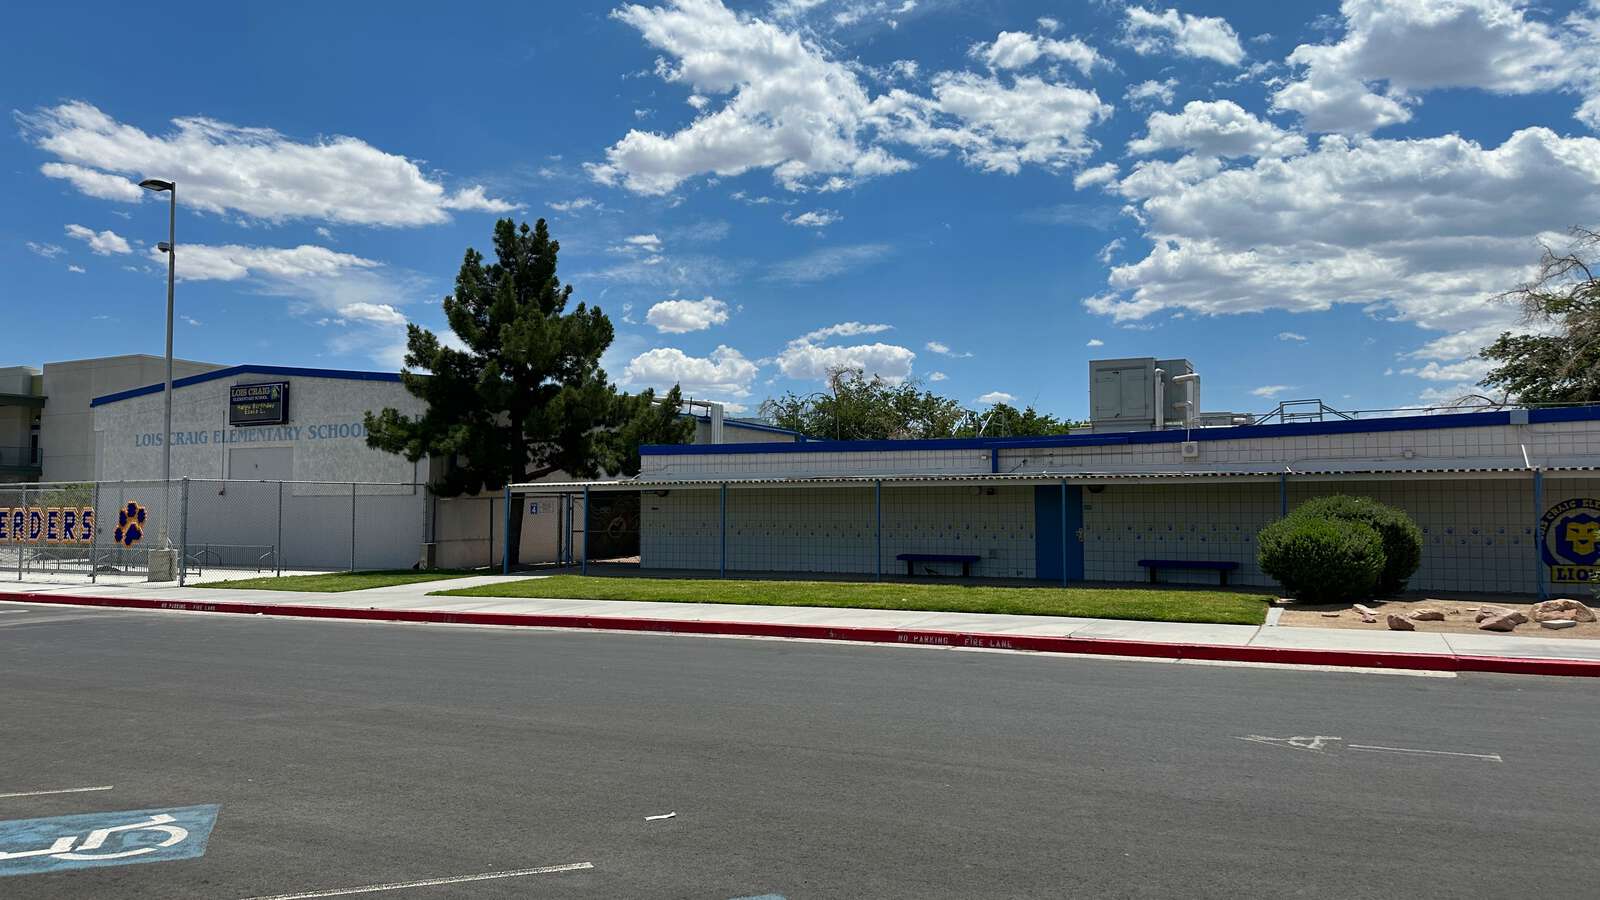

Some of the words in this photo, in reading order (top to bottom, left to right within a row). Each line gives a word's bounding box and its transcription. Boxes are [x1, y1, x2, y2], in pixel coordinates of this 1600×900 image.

[248, 387, 270, 396] CRAIG
[135, 432, 163, 448] LOIS
[169, 430, 208, 447] CRAIG
[213, 426, 303, 444] ELEMENTARY
[0, 507, 95, 544] EADERS
[1557, 567, 1600, 581] LIO
[897, 634, 909, 642] NO
[913, 635, 949, 645] PARKING
[964, 637, 984, 647] FIRE
[989, 639, 1013, 649] LANE
